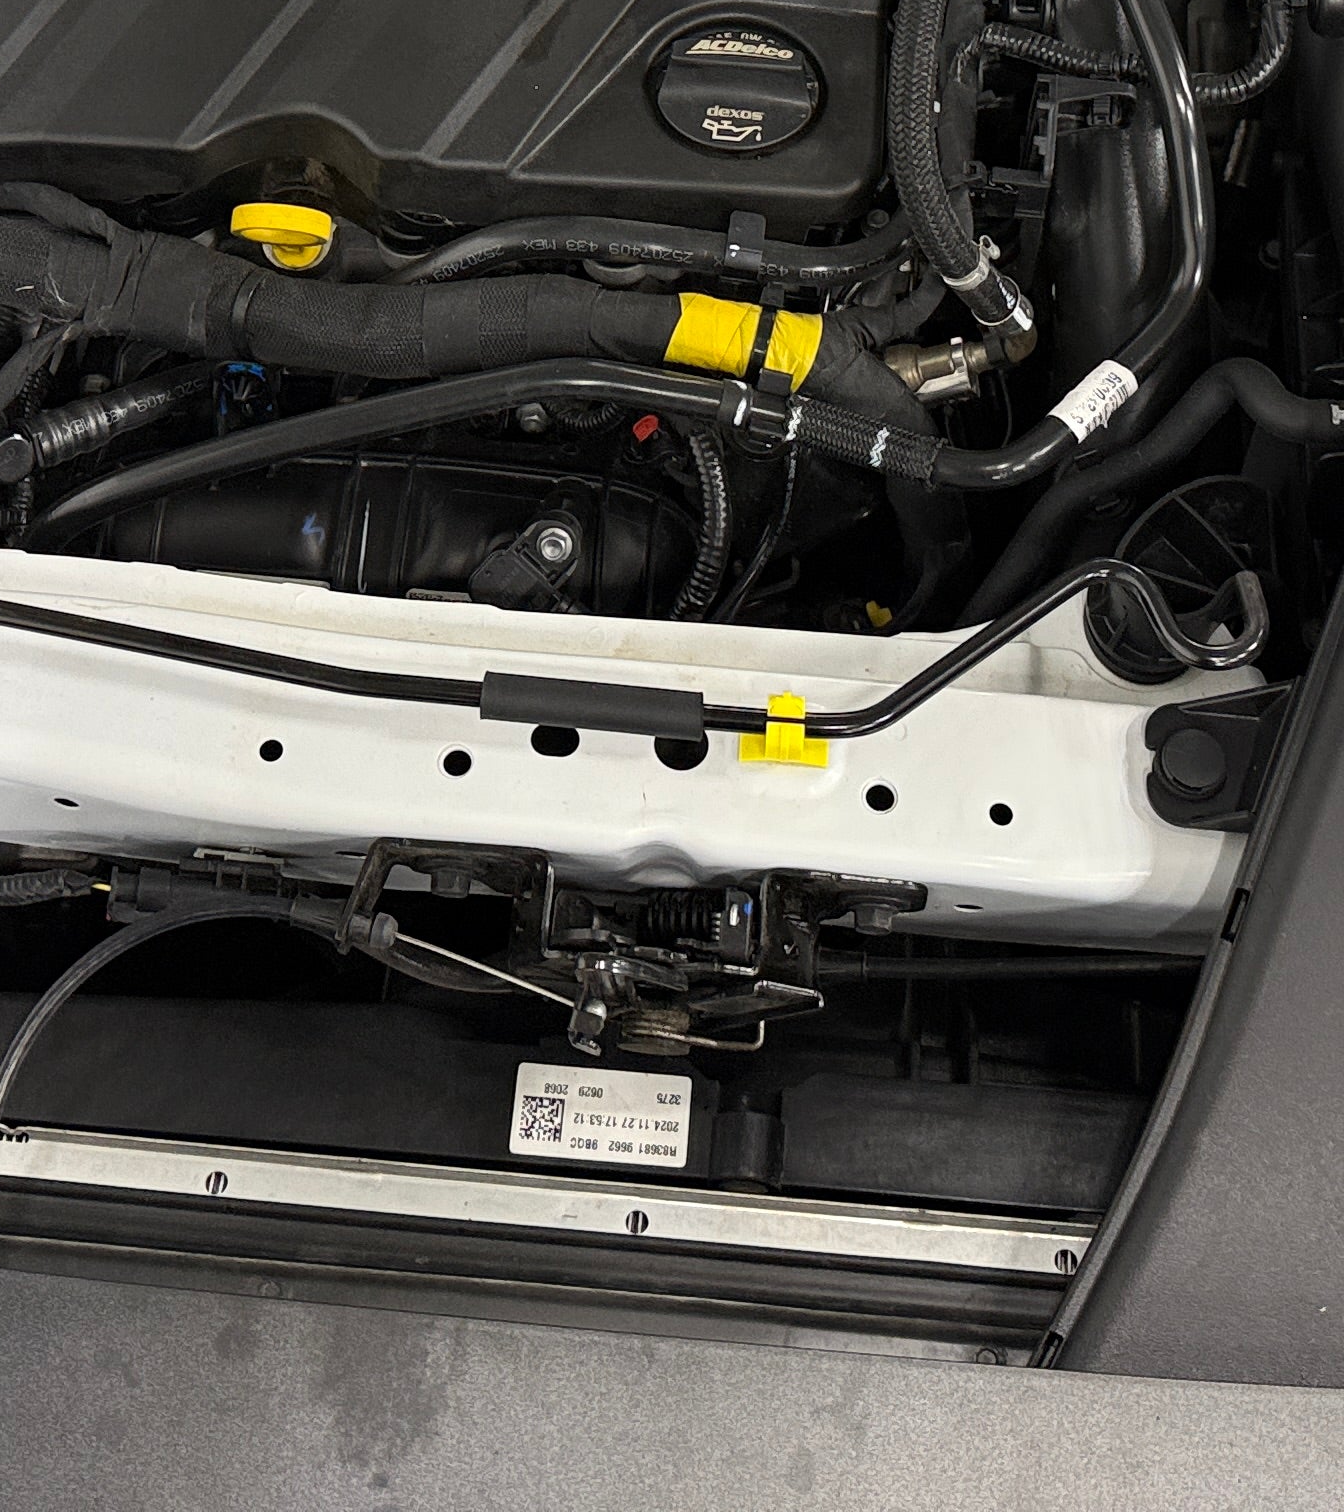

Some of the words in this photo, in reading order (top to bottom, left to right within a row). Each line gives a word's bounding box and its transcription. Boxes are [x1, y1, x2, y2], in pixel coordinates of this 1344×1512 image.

[690, 39, 794, 59] ACDelco
[706, 105, 765, 121] dexos
[521, 239, 556, 251] MEX
[565, 239, 599, 253] 433
[608, 242, 694, 264] 25207409
[433, 244, 504, 282] 25207409
[544, 1083, 568, 1095] 2068
[657, 1092, 681, 1105] 3275
[573, 1112, 617, 1127] 17:53:12
[608, 1140, 634, 1153] 9662
[638, 1142, 677, 1157] R83681
